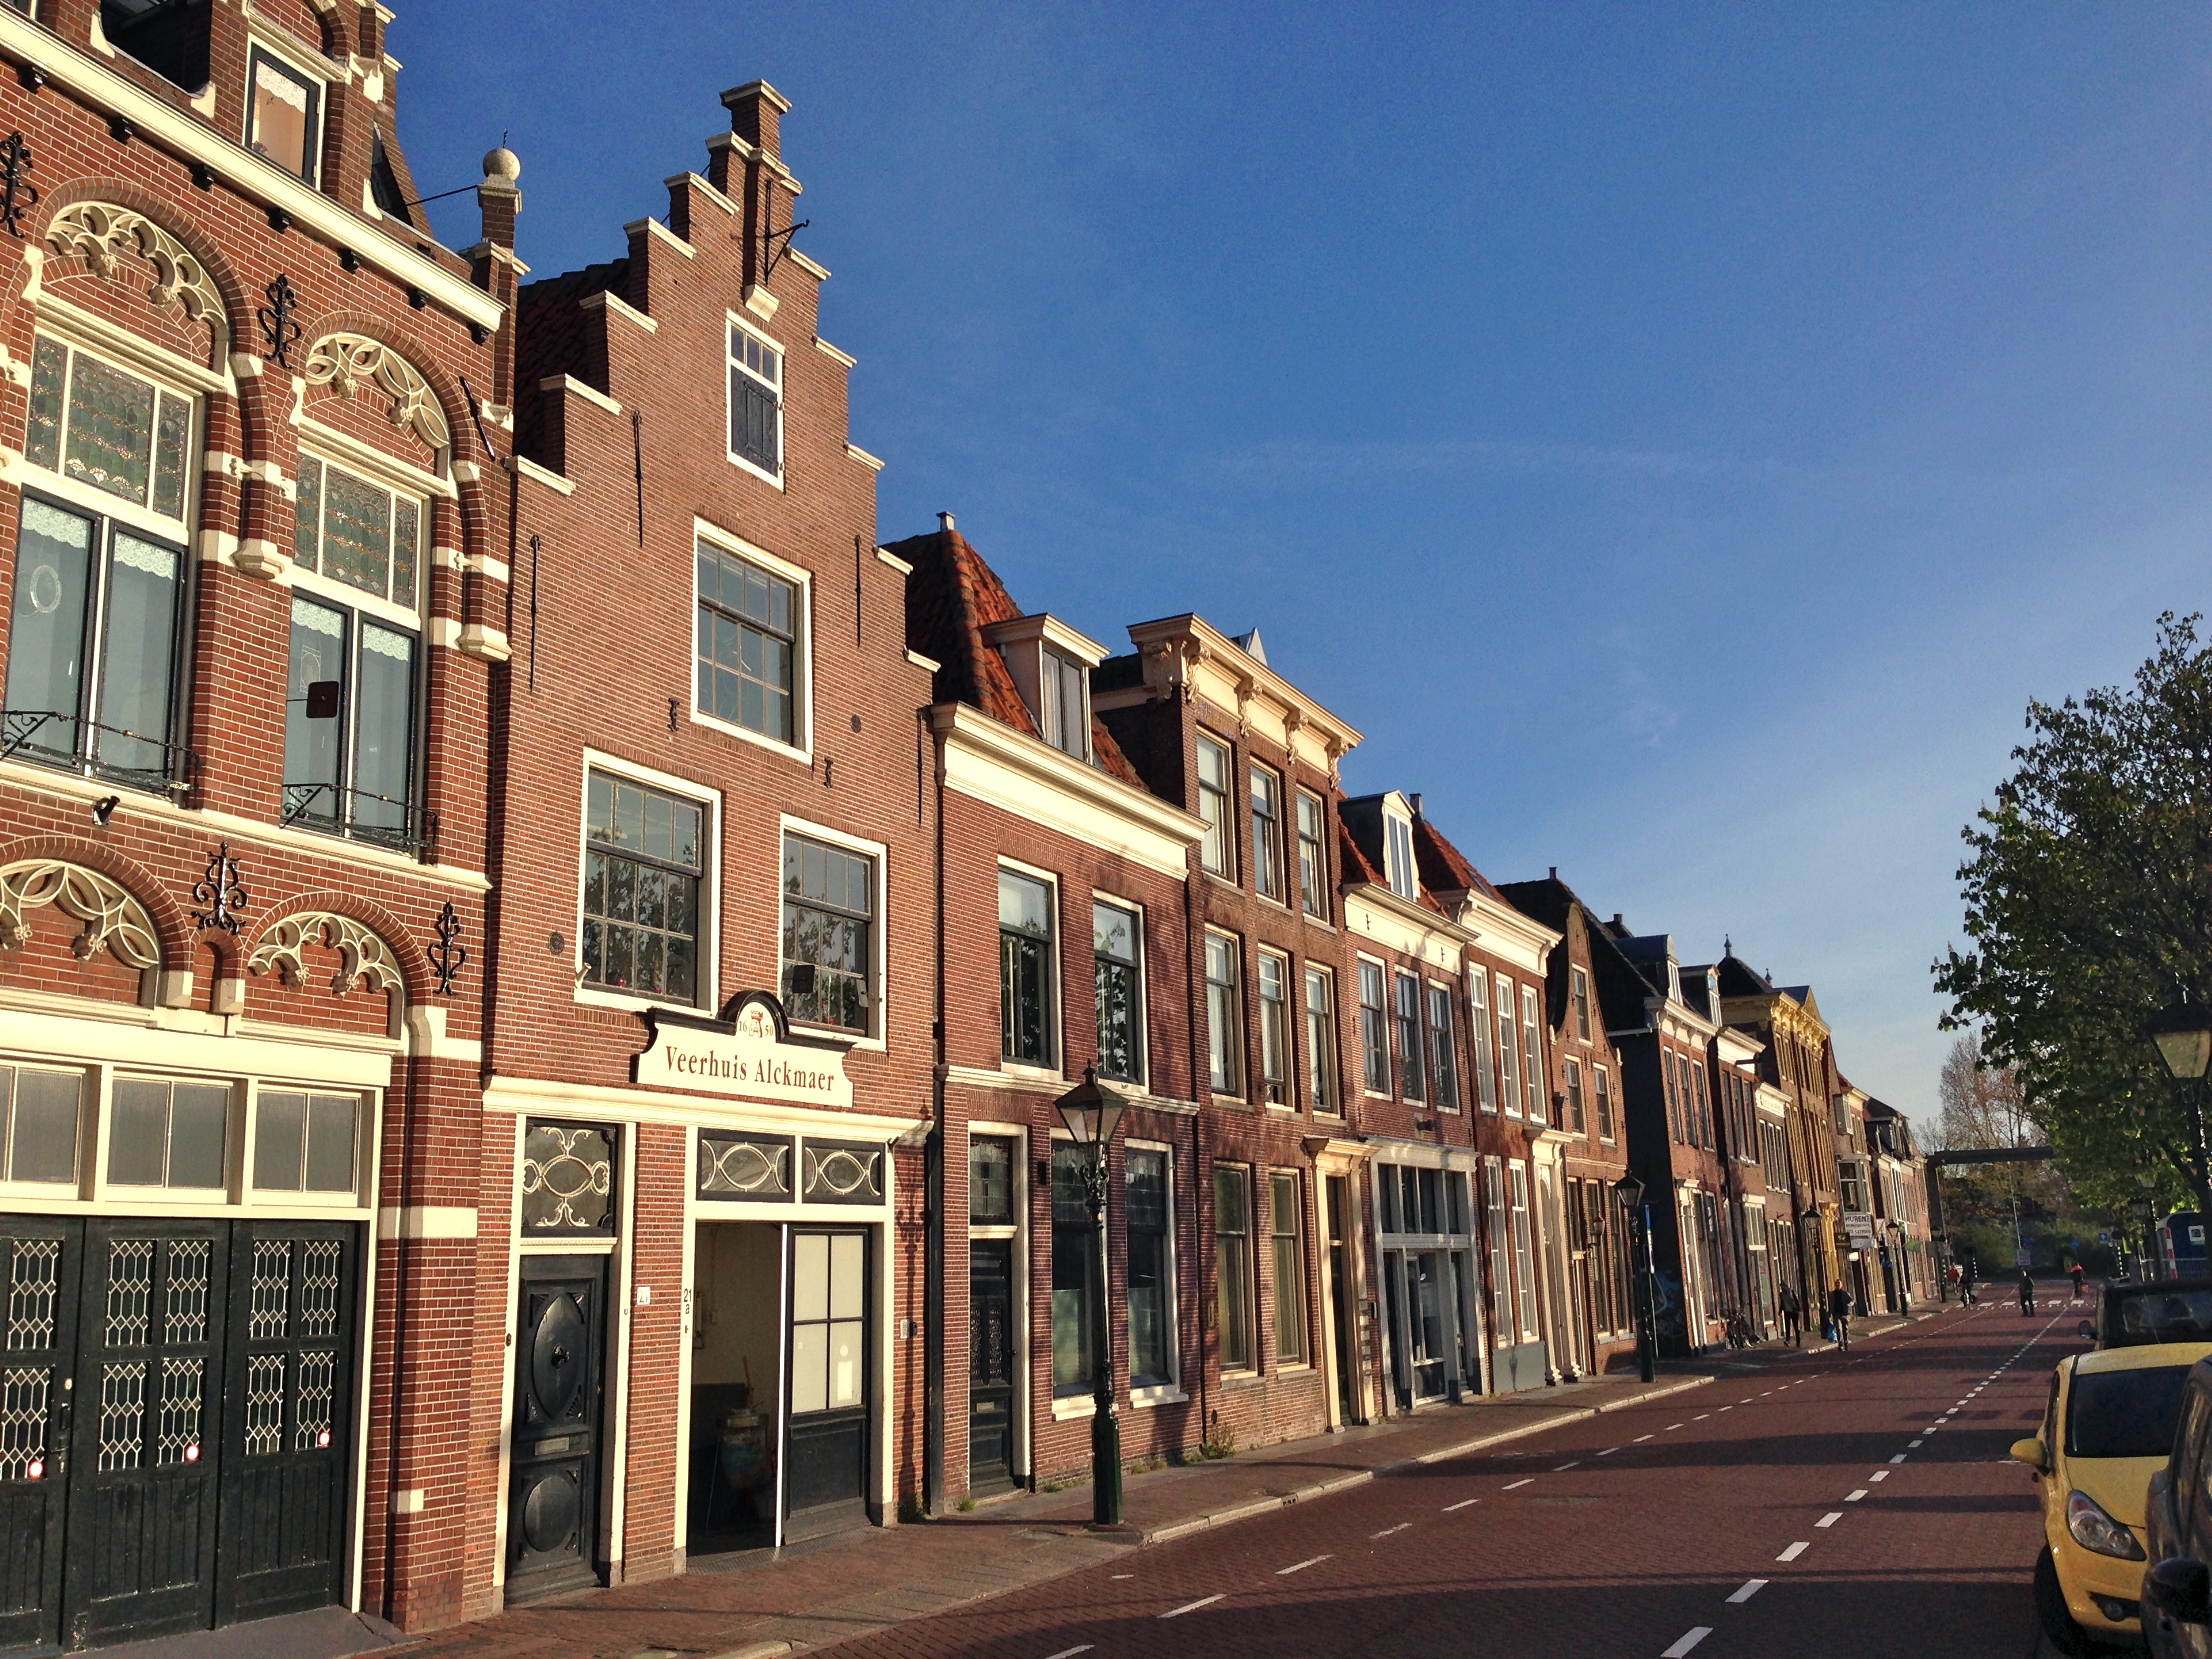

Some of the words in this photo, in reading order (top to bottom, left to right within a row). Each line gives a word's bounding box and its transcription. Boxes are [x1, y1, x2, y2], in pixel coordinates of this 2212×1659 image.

[739, 1019, 747, 1032] 16
[764, 1025, 774, 1037] 50
[665, 1046, 747, 1081] Veerhuis
[754, 1059, 835, 1092] Alckmaer
[683, 1288, 692, 1303] 21
[685, 1303, 690, 1315] a
